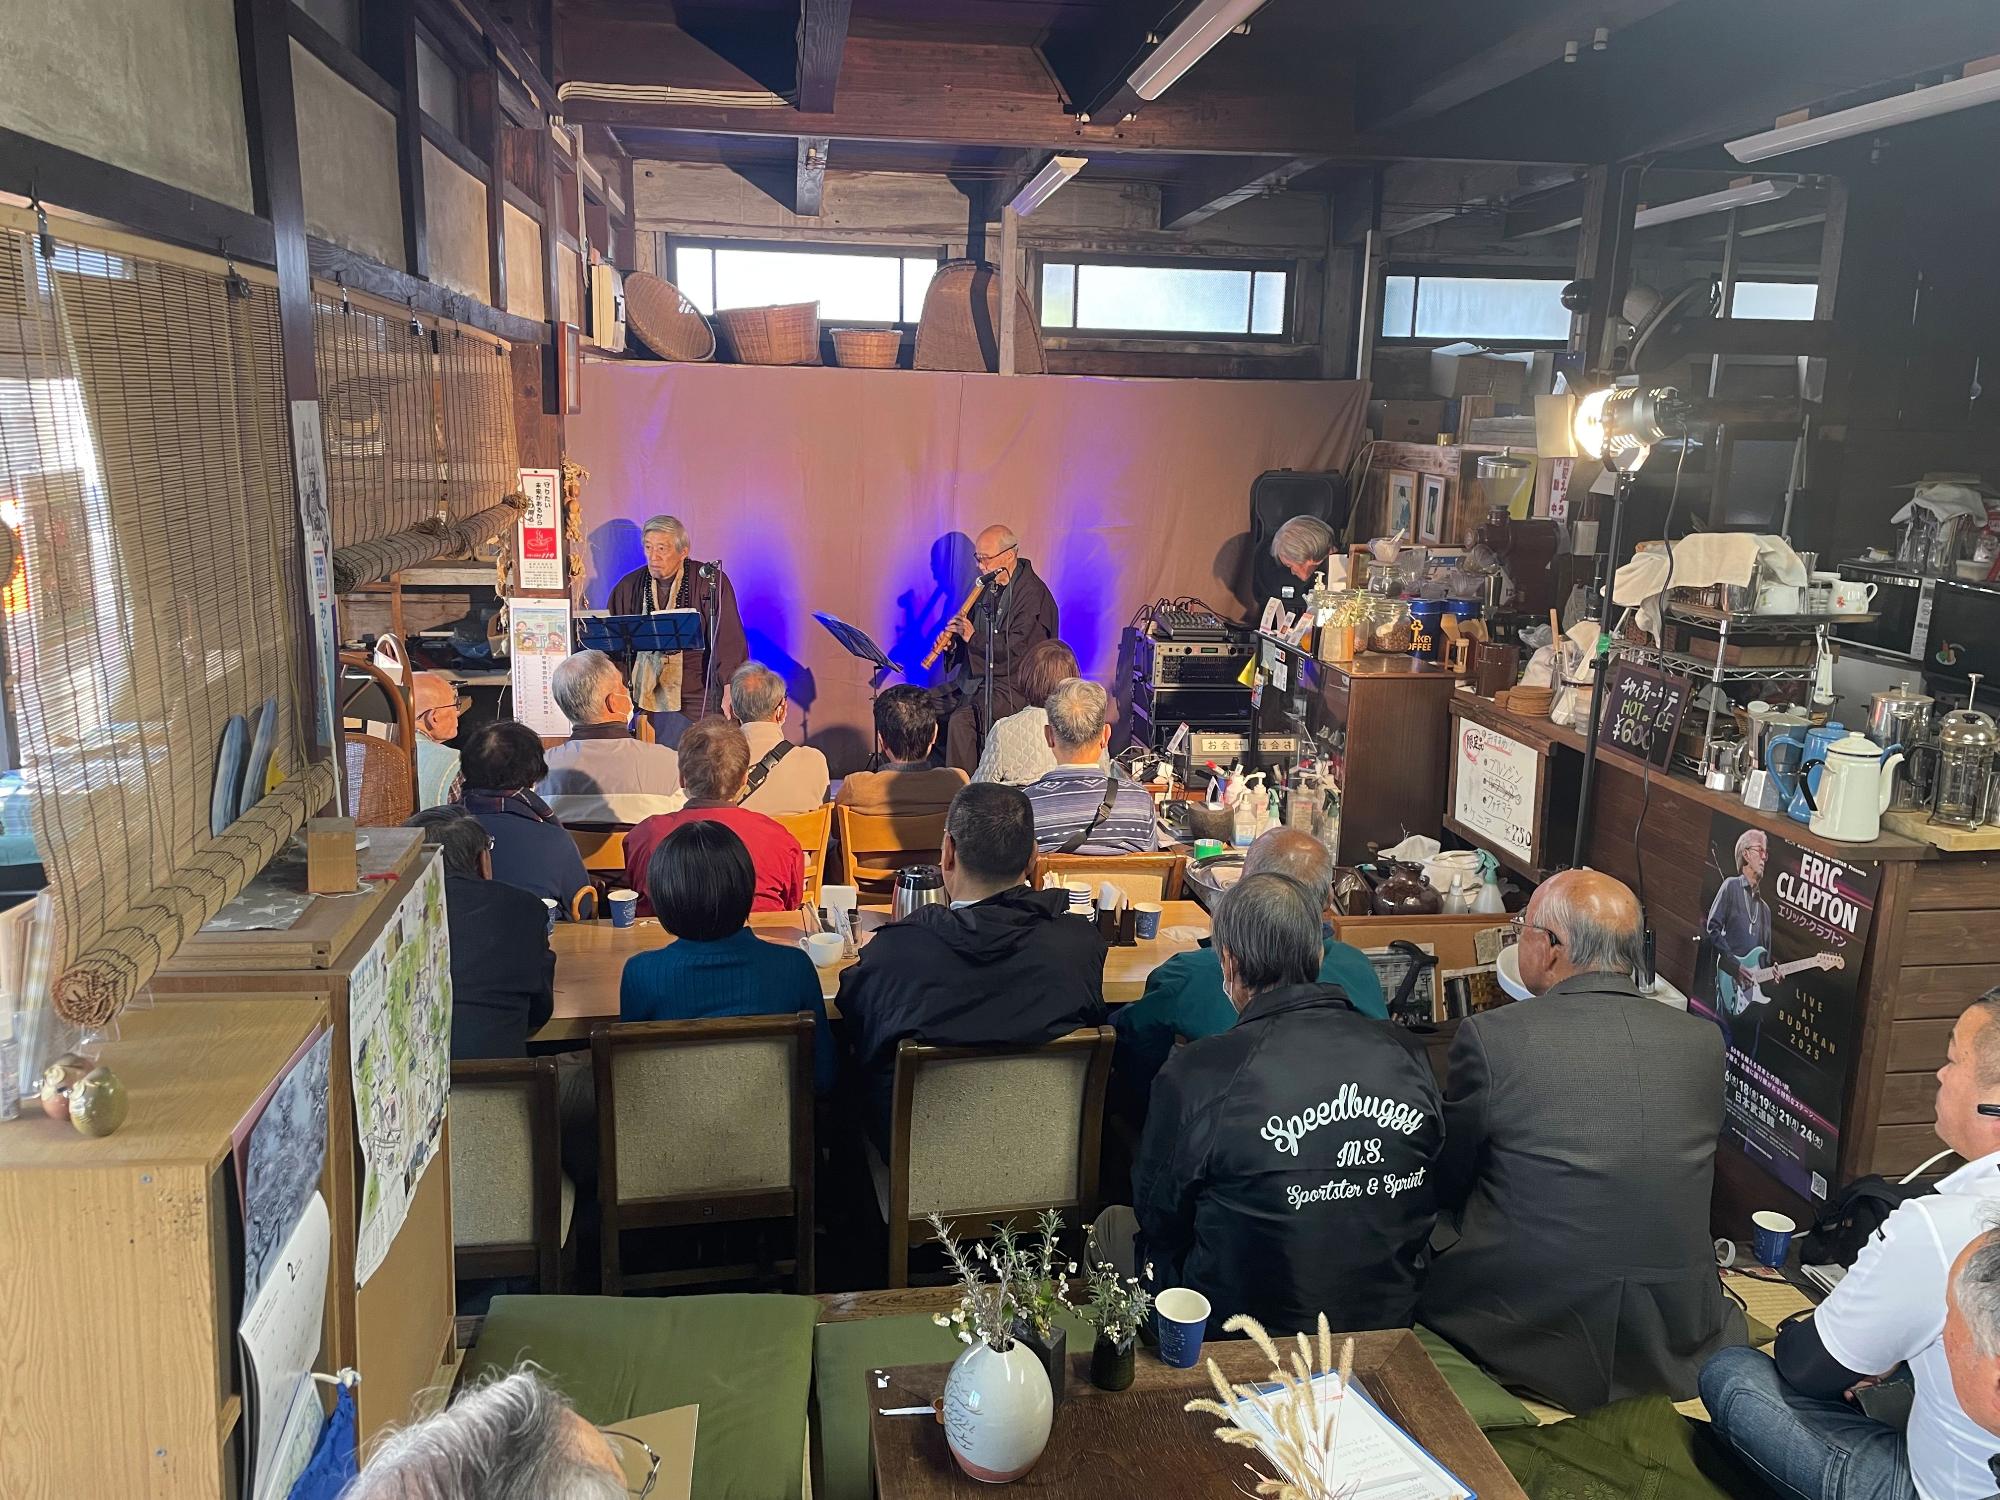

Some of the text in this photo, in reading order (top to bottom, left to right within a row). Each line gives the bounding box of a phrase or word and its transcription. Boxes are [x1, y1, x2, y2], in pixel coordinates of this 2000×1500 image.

[1408, 642, 1432, 651] OFFEE
[1612, 713, 1655, 750] ¥600
[1620, 699, 1645, 720] HOT
[1654, 711, 1675, 732] CE
[1207, 740, 1244, 750] お会計
[1799, 853, 1843, 894] ERIC
[1776, 871, 1859, 933] CLAPTON
[1796, 987, 1823, 1012] LIVE
[1801, 1008, 1815, 1023] AT
[1778, 1009, 1836, 1055] BUDOKAN
[1790, 1033, 1820, 1060] 2025
[1260, 1082, 1425, 1157] Speedbuggy
[1735, 1090, 1775, 1128] 日本武道館
[1336, 1138, 1385, 1168] M.S.
[1286, 1166, 1427, 1210] Sportster & Sprint
